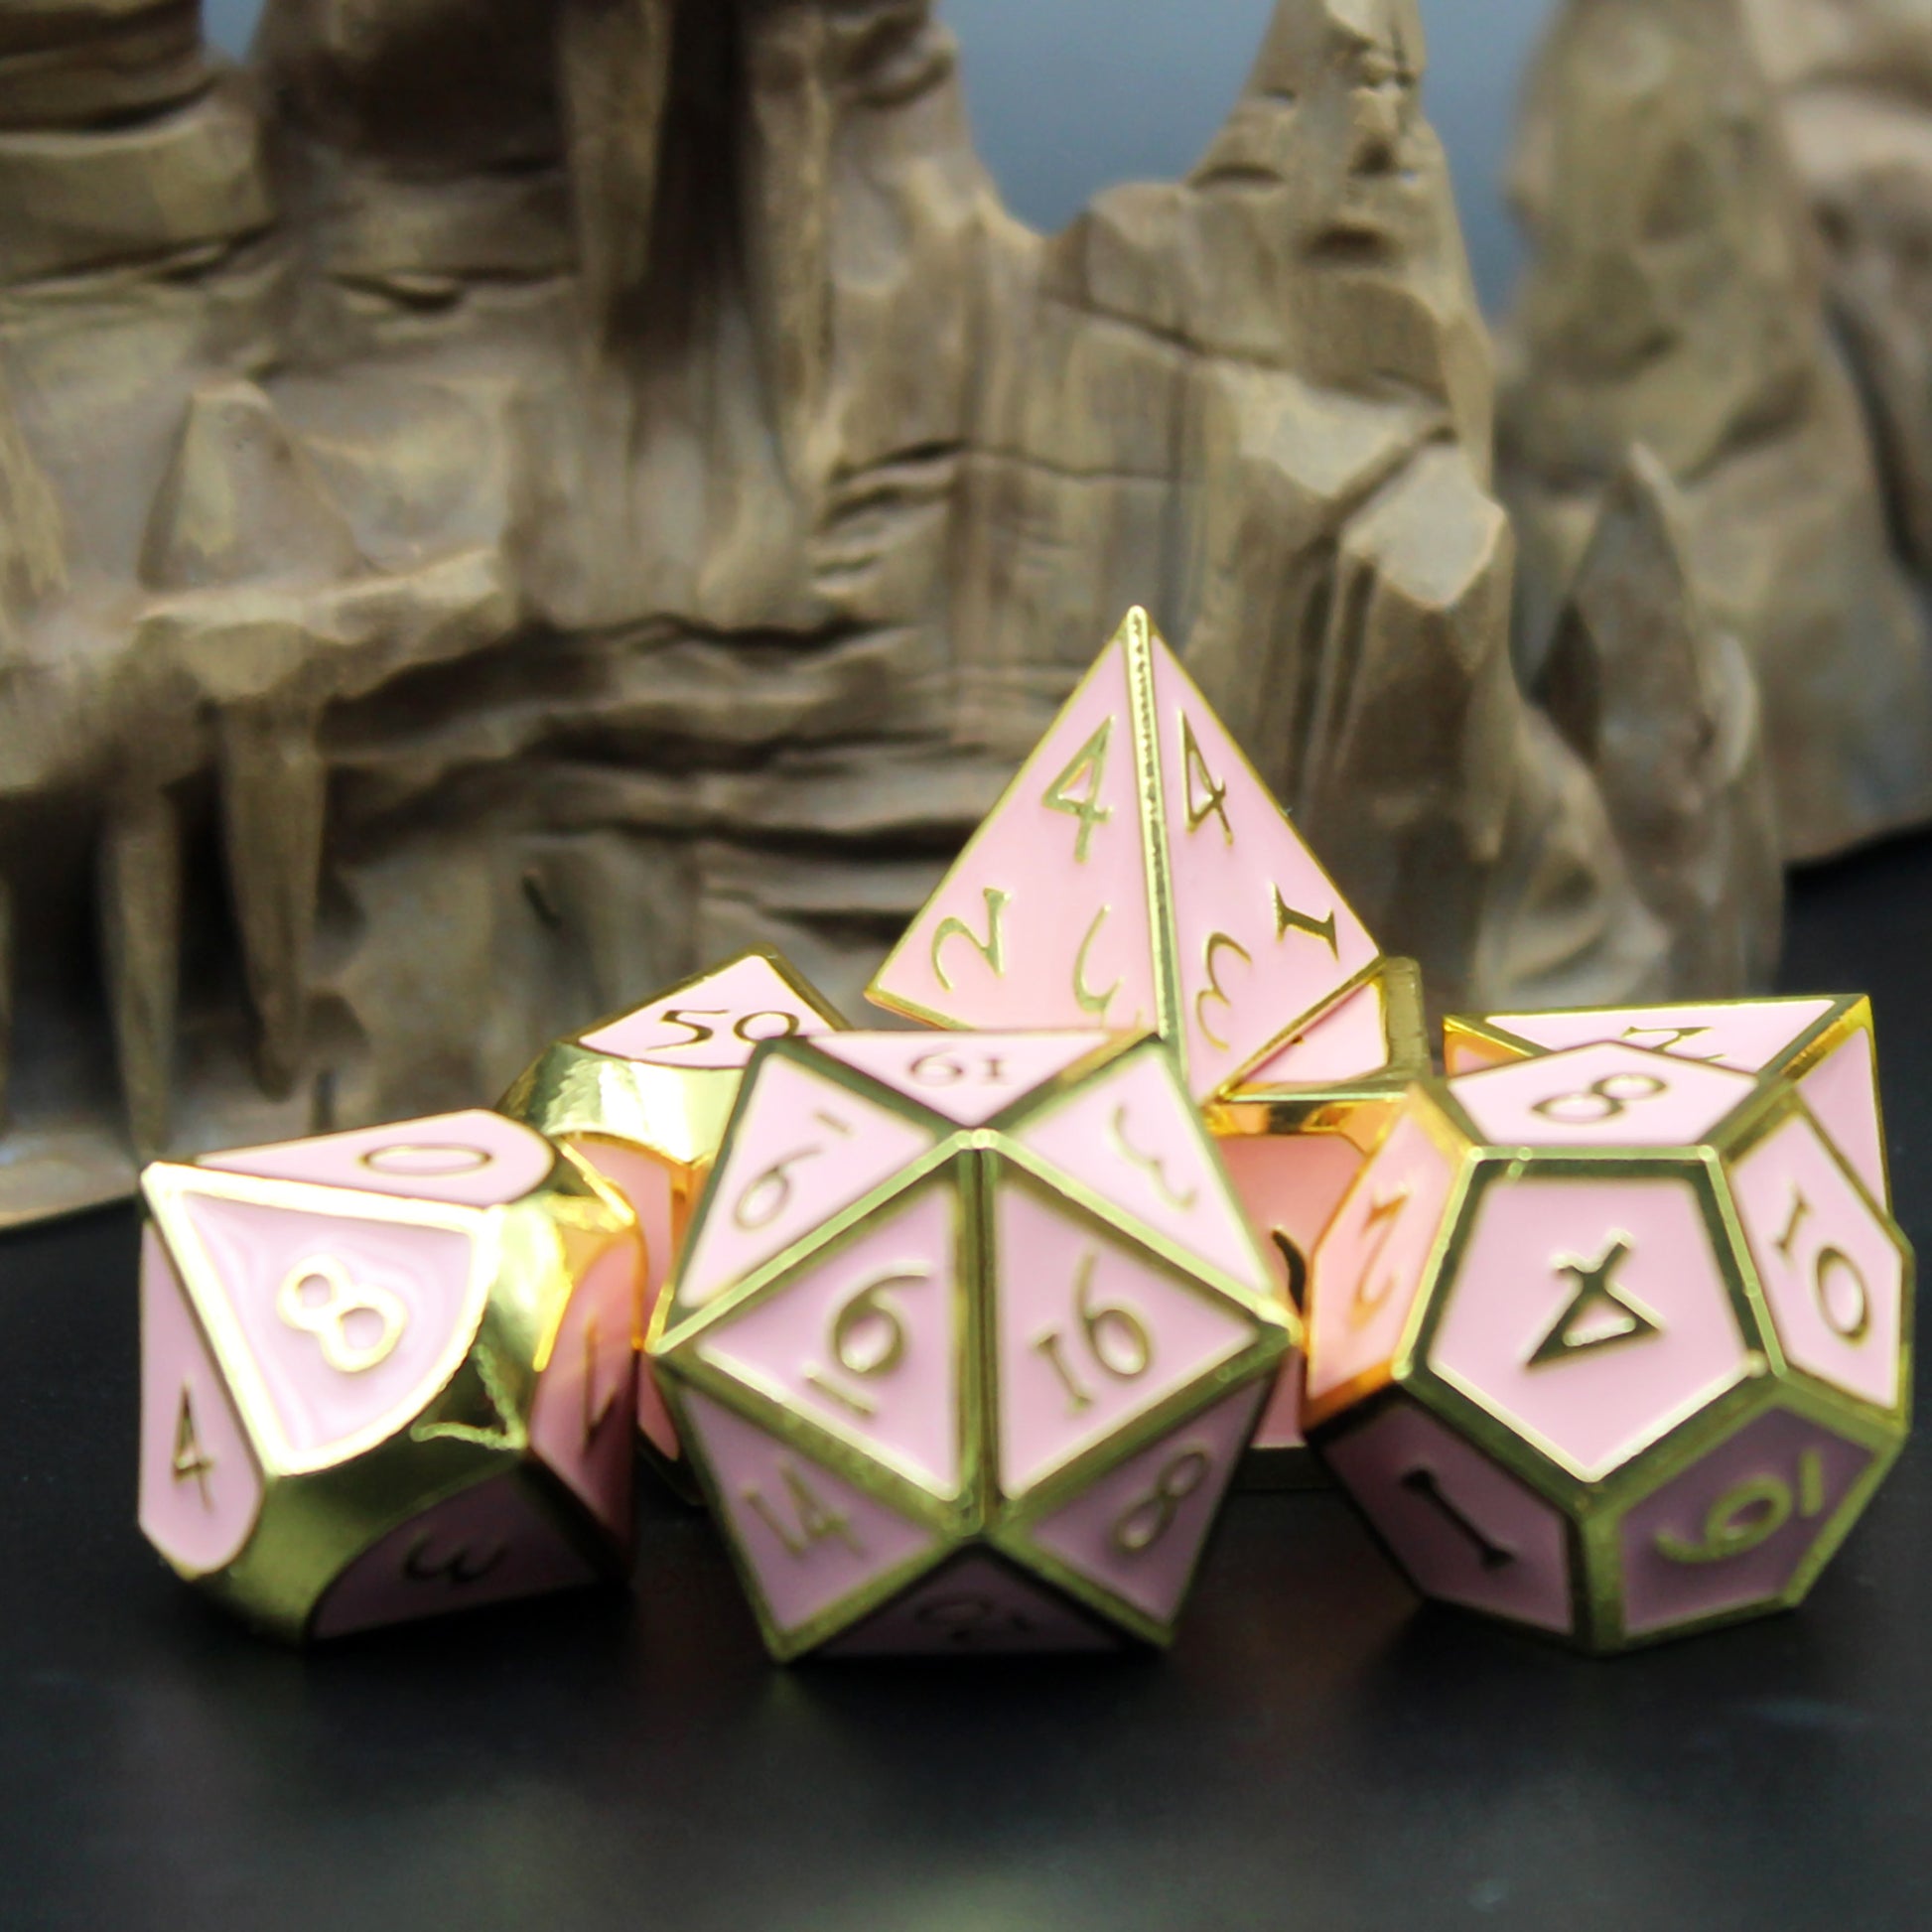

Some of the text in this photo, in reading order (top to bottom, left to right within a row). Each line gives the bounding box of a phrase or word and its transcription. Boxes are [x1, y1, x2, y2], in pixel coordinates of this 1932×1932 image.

[1041, 714, 1116, 864] 4
[1177, 707, 1234, 847] 4
[931, 888, 1012, 993] 2
[1271, 881, 1339, 961] 1
[643, 1008, 800, 1050] 50
[1195, 931, 1253, 1052] 3
[1530, 1072, 1668, 1125] 8
[356, 1143, 491, 1177] 0
[275, 1254, 408, 1374] 8
[1525, 1231, 1661, 1367] 4
[1774, 1181, 1872, 1348] 10
[1034, 1247, 1152, 1412] 16
[172, 1383, 213, 1512] 4
[740, 1453, 868, 1559] 14
[1108, 1449, 1211, 1553] 8
